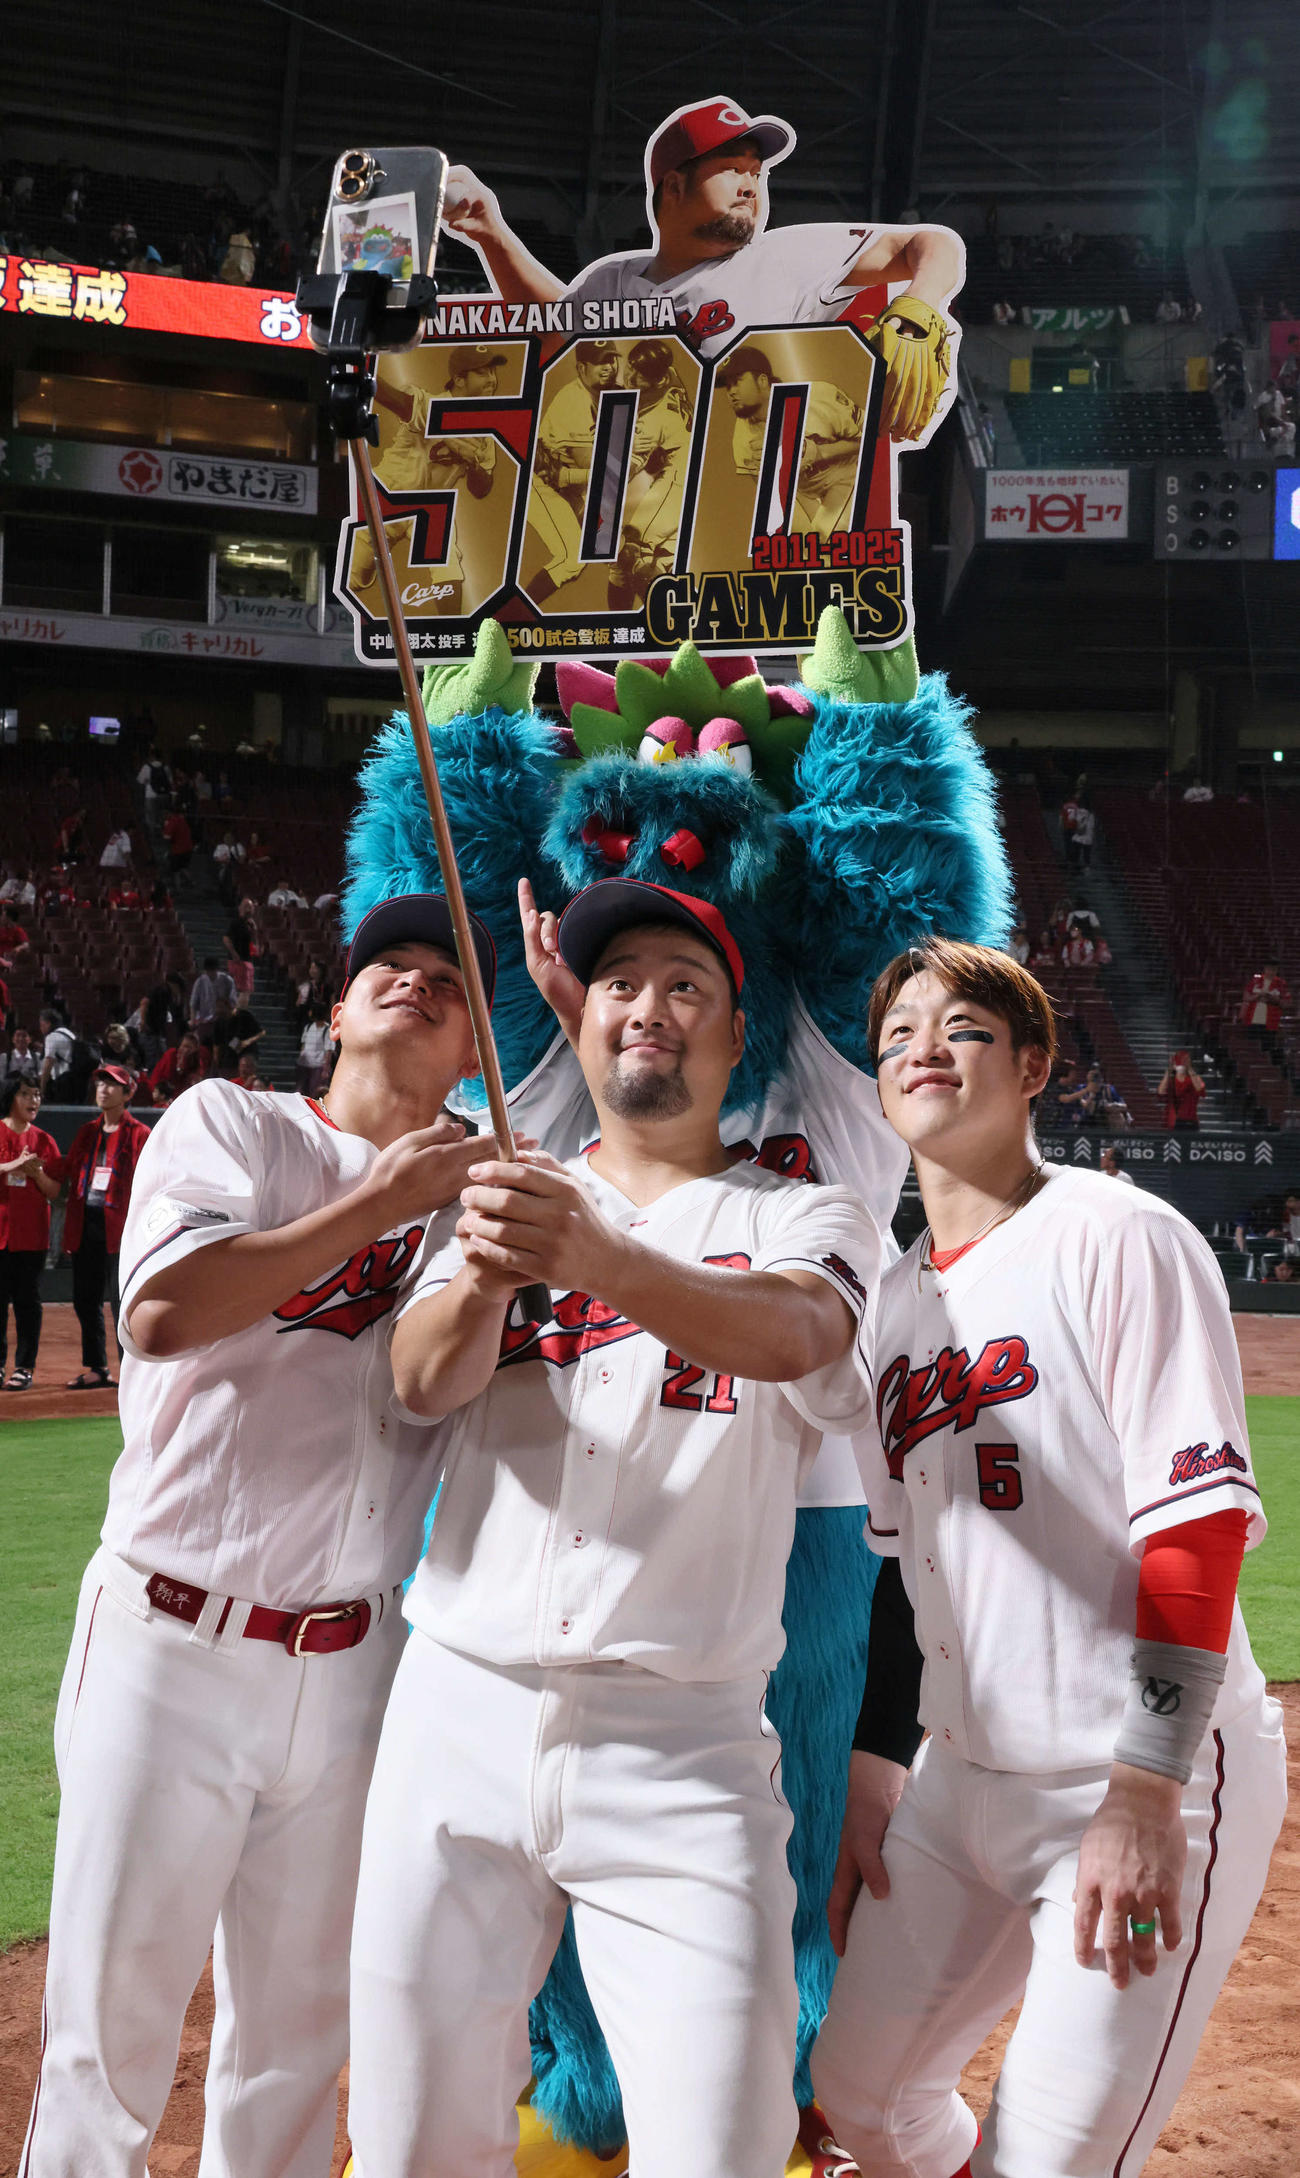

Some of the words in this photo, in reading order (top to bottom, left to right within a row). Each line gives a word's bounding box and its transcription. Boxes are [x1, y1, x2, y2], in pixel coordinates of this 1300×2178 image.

[18, 260, 128, 326] 達成
[426, 301, 574, 336] NAKAZAKI
[582, 297, 677, 331] SHOTA
[174, 461, 301, 502] やまだ屋
[345, 325, 884, 621] 500
[1166, 476, 1179, 495] B
[991, 505, 1026, 522] ホウ
[1086, 505, 1122, 522] コク
[1167, 505, 1178, 523] S
[753, 530, 902, 570] 2011-2025
[400, 583, 455, 607] Carp
[646, 566, 906, 646] GAMES
[181, 632, 265, 657] キャリカレ
[1190, 1150, 1246, 1162] DAISO
[659, 1349, 739, 1415] 21
[974, 1443, 1024, 1512] 5
